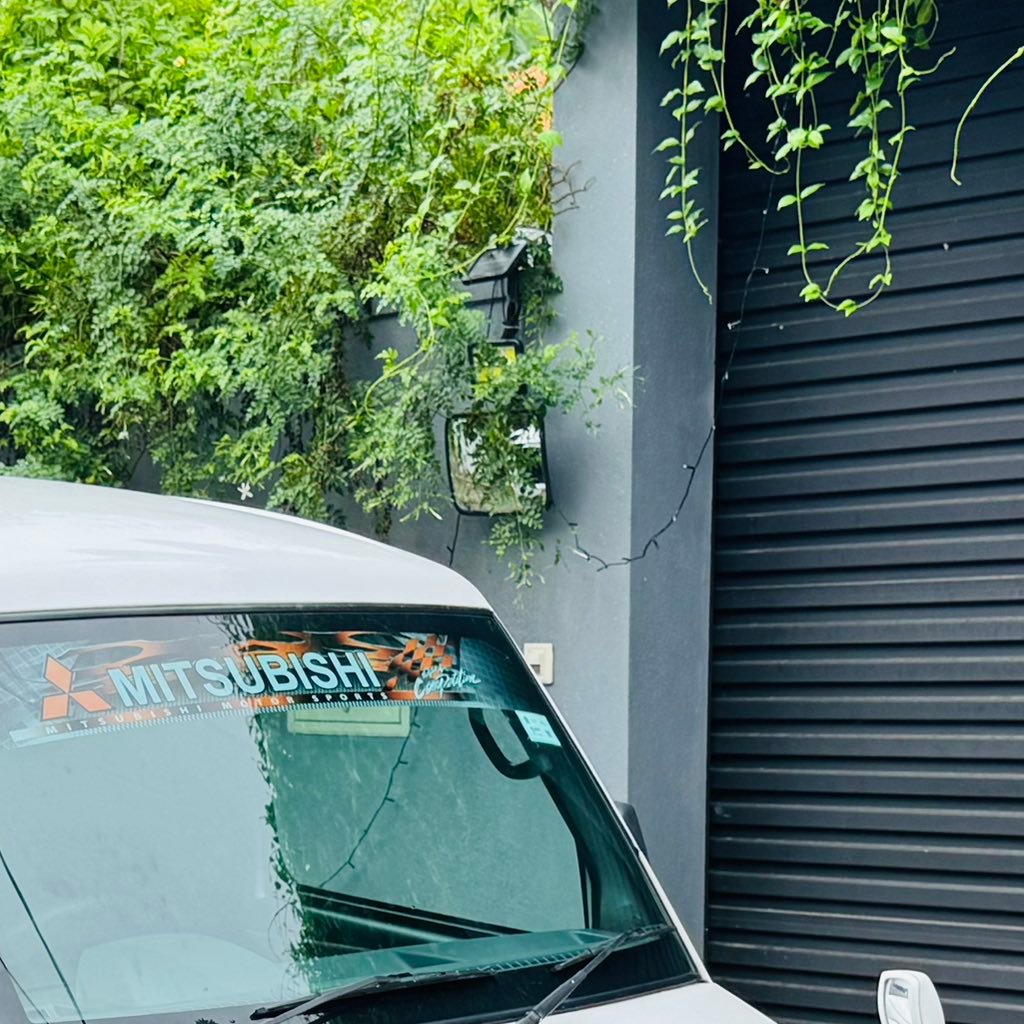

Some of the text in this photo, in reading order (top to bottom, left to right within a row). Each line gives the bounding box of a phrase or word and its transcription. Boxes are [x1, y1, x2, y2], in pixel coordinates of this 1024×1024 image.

[107, 650, 381, 708] MITSUBISHI
[45, 690, 388, 735] MITSUBISHI MOTOR SPORTS
